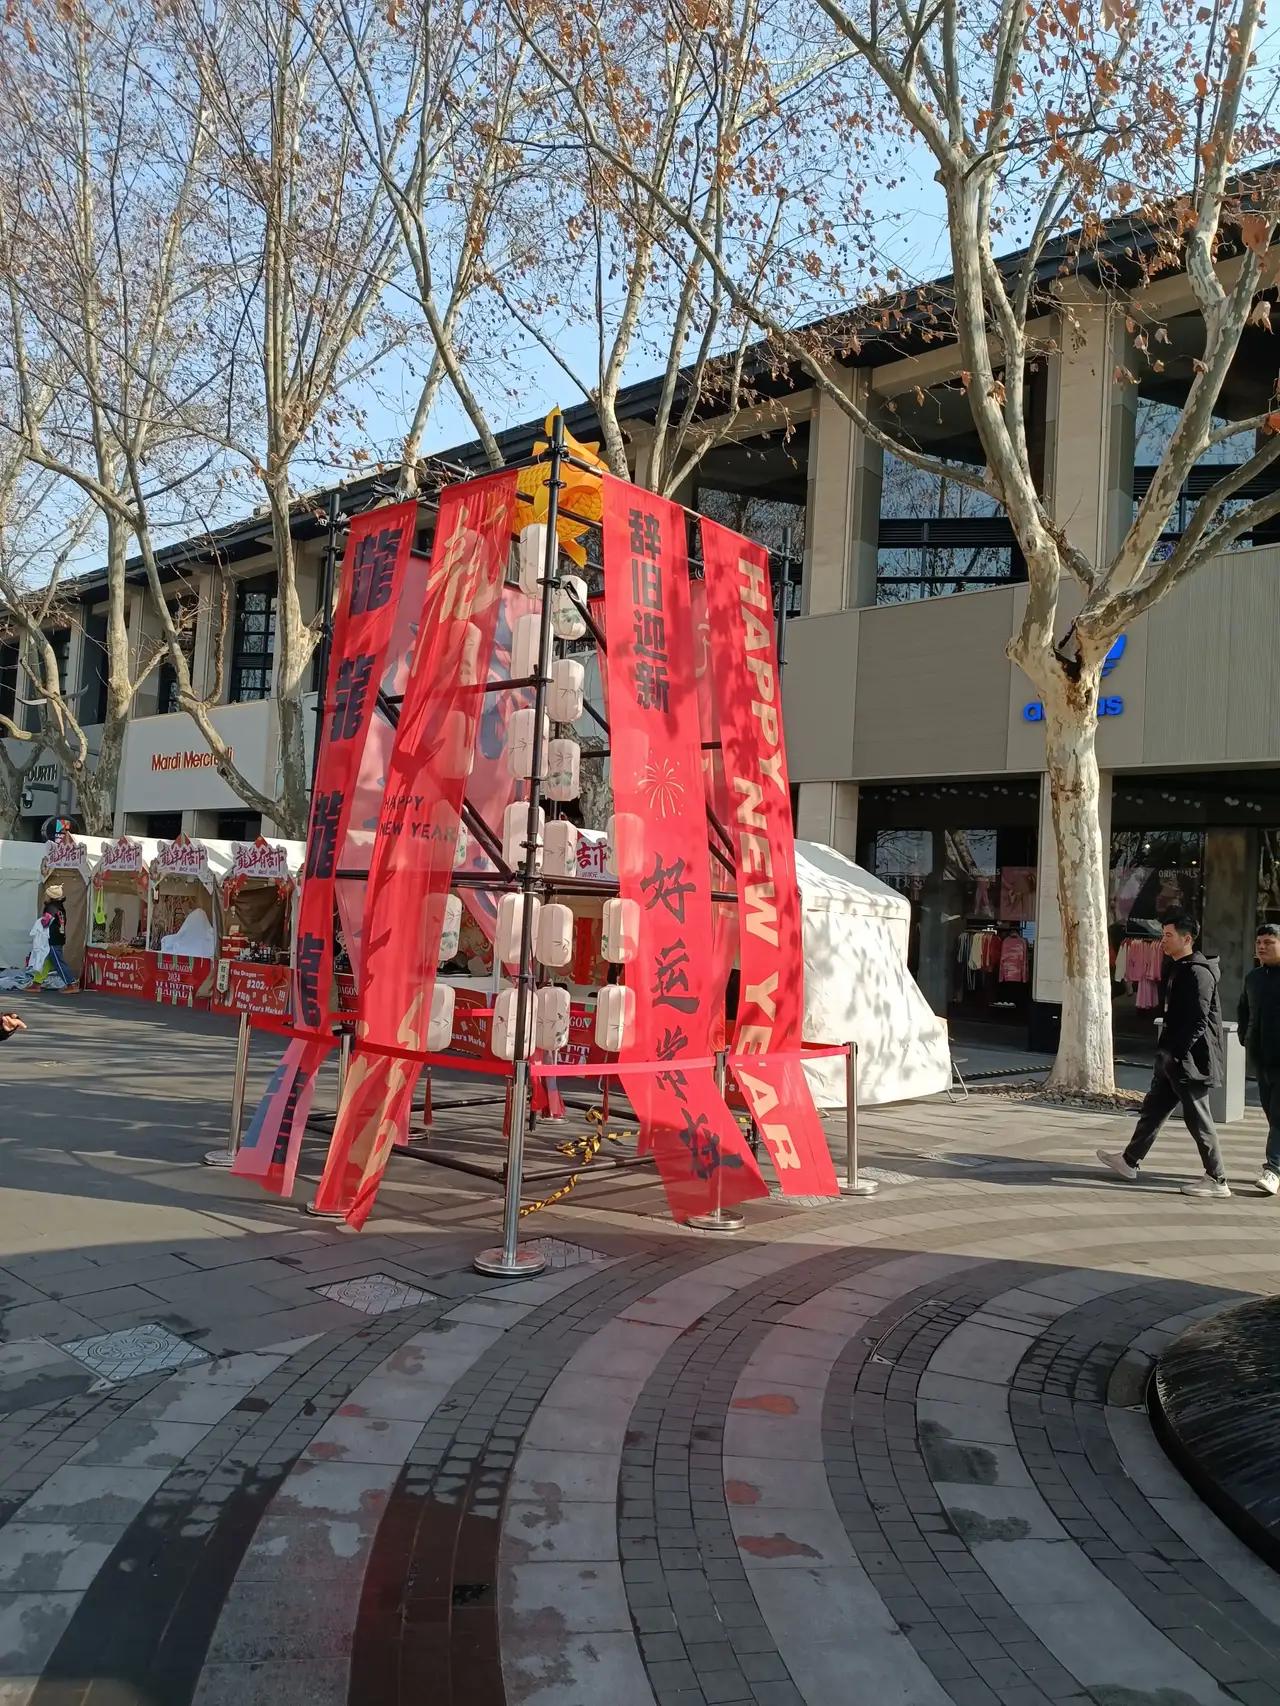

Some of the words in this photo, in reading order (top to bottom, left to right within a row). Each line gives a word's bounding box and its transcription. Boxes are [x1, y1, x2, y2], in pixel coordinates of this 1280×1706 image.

[628, 507, 669, 714] 辞旧迎新
[738, 556, 787, 798] HAPPY
[152, 752, 181, 770] Mardi
[379, 820, 403, 837] NEW
[411, 822, 457, 842] YEAR
[384, 795, 424, 812] HAPPY
[734, 775, 779, 948] NEW
[733, 970, 801, 1171] YEAR
